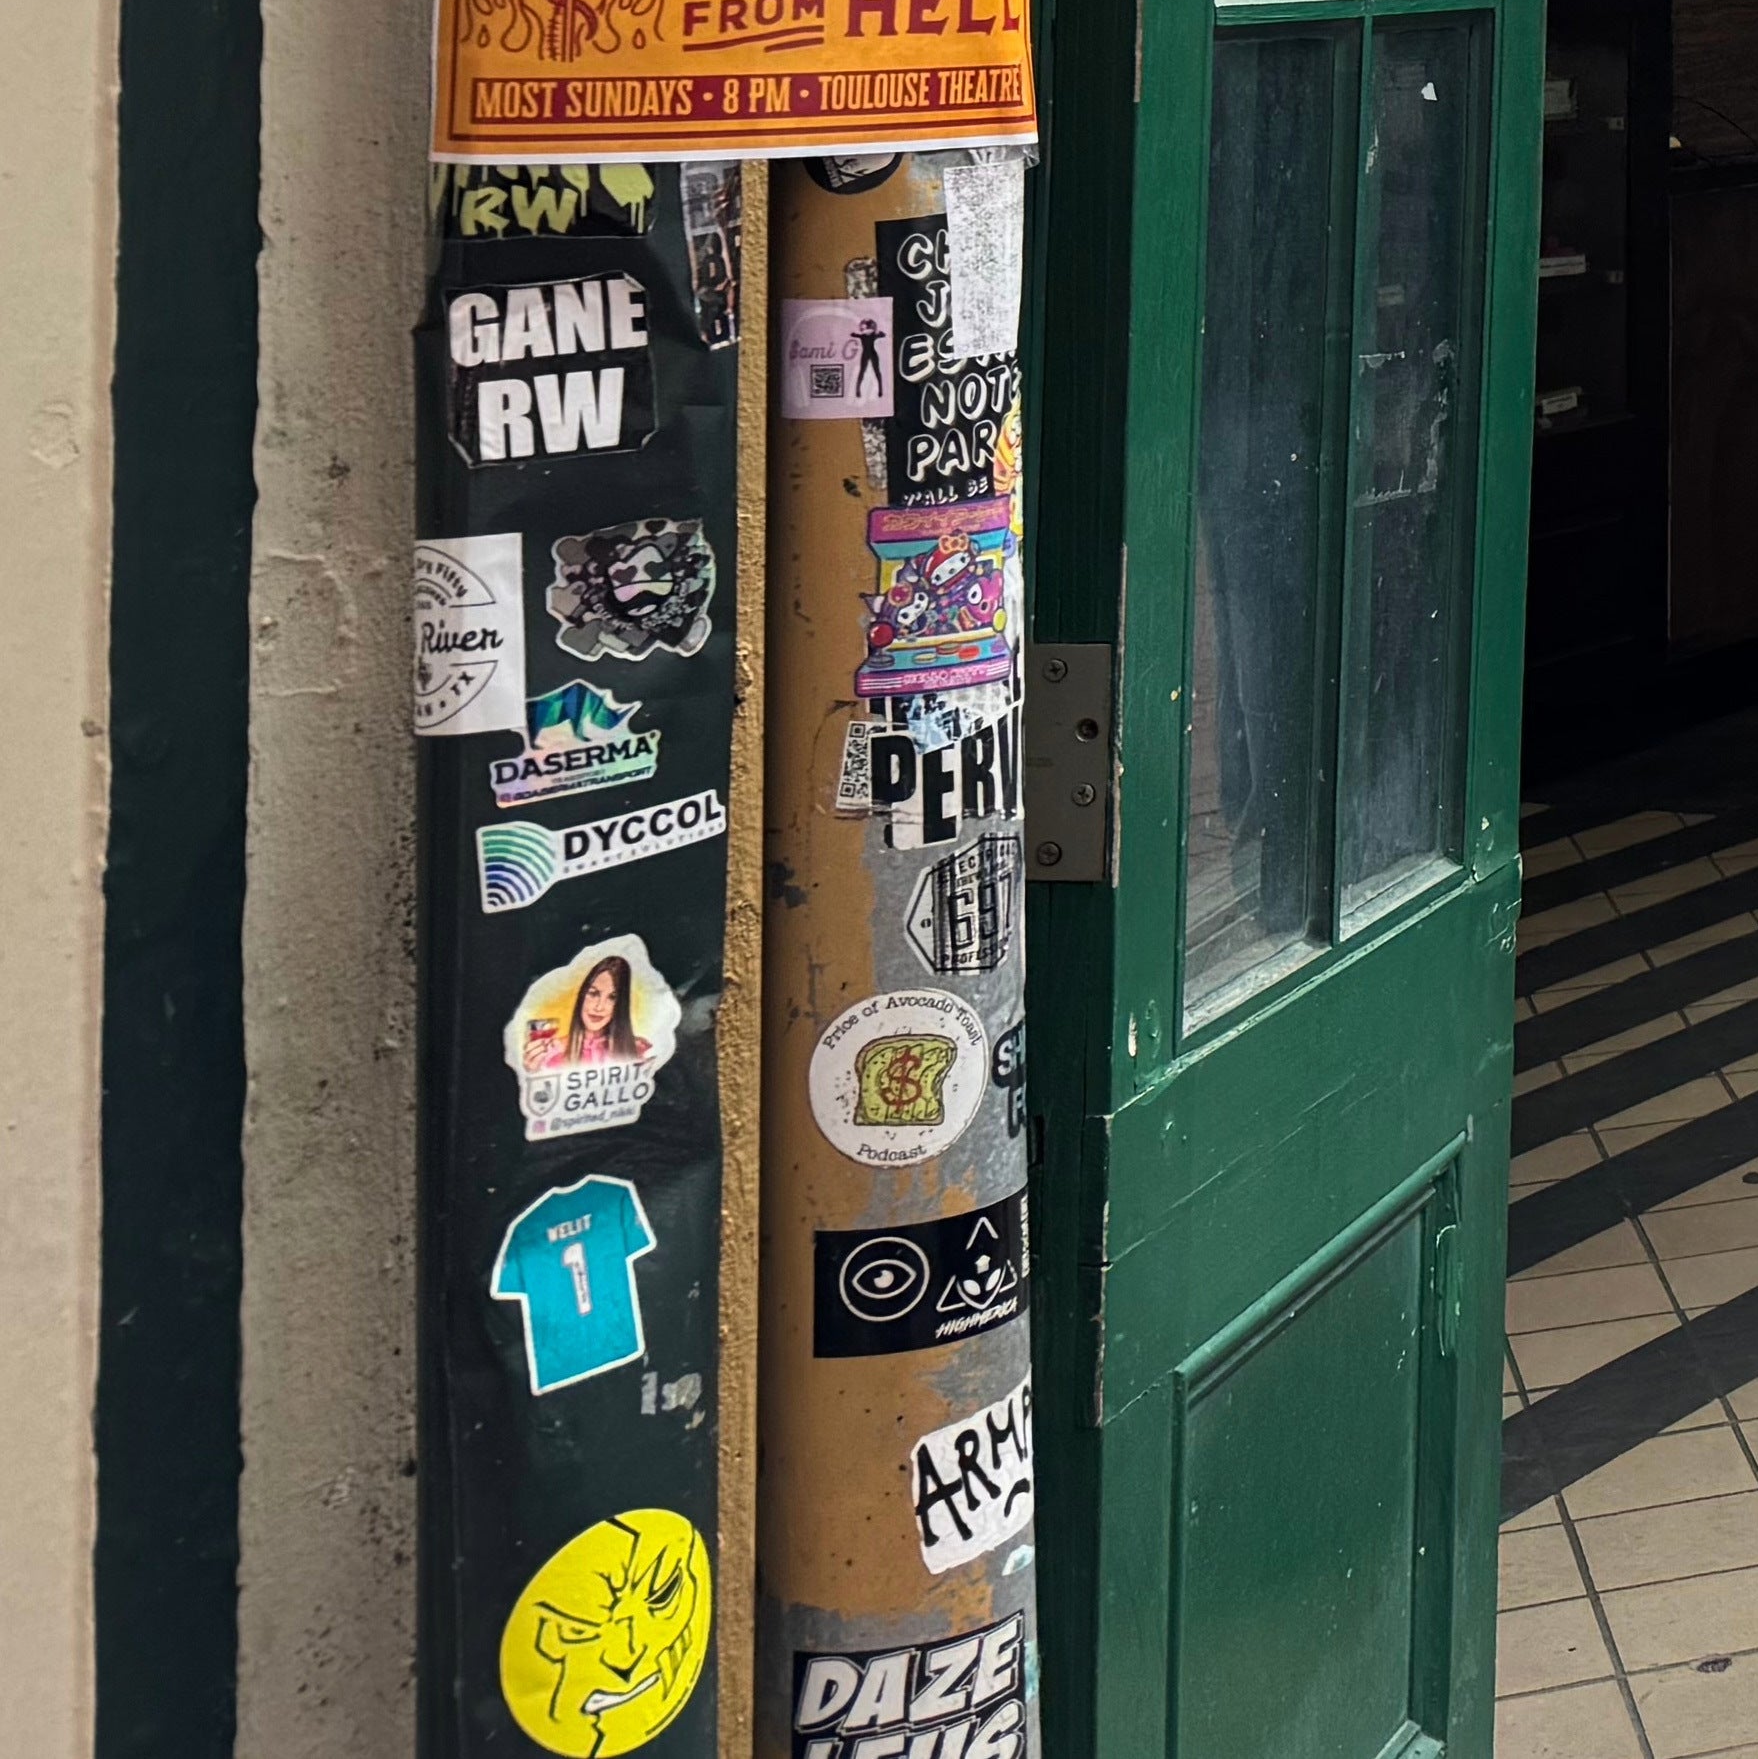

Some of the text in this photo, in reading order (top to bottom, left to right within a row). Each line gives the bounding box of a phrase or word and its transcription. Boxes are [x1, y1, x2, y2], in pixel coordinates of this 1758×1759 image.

[476, 64, 1022, 120] MOST SUNDAYS 8 PM TOULOUSE THEATRE
[450, 278, 649, 368] GANE
[477, 367, 625, 462] RW
[421, 619, 504, 655] River
[494, 734, 653, 785] DASERMA
[564, 793, 722, 861] DYCCOL
[823, 995, 983, 1050] Price of Avocado Toast
[564, 1082, 649, 1112] GALLO
[567, 1063, 644, 1090] SPIRIT
[856, 1143, 928, 1162] Podcast
[797, 1617, 1021, 1730] DAZE
